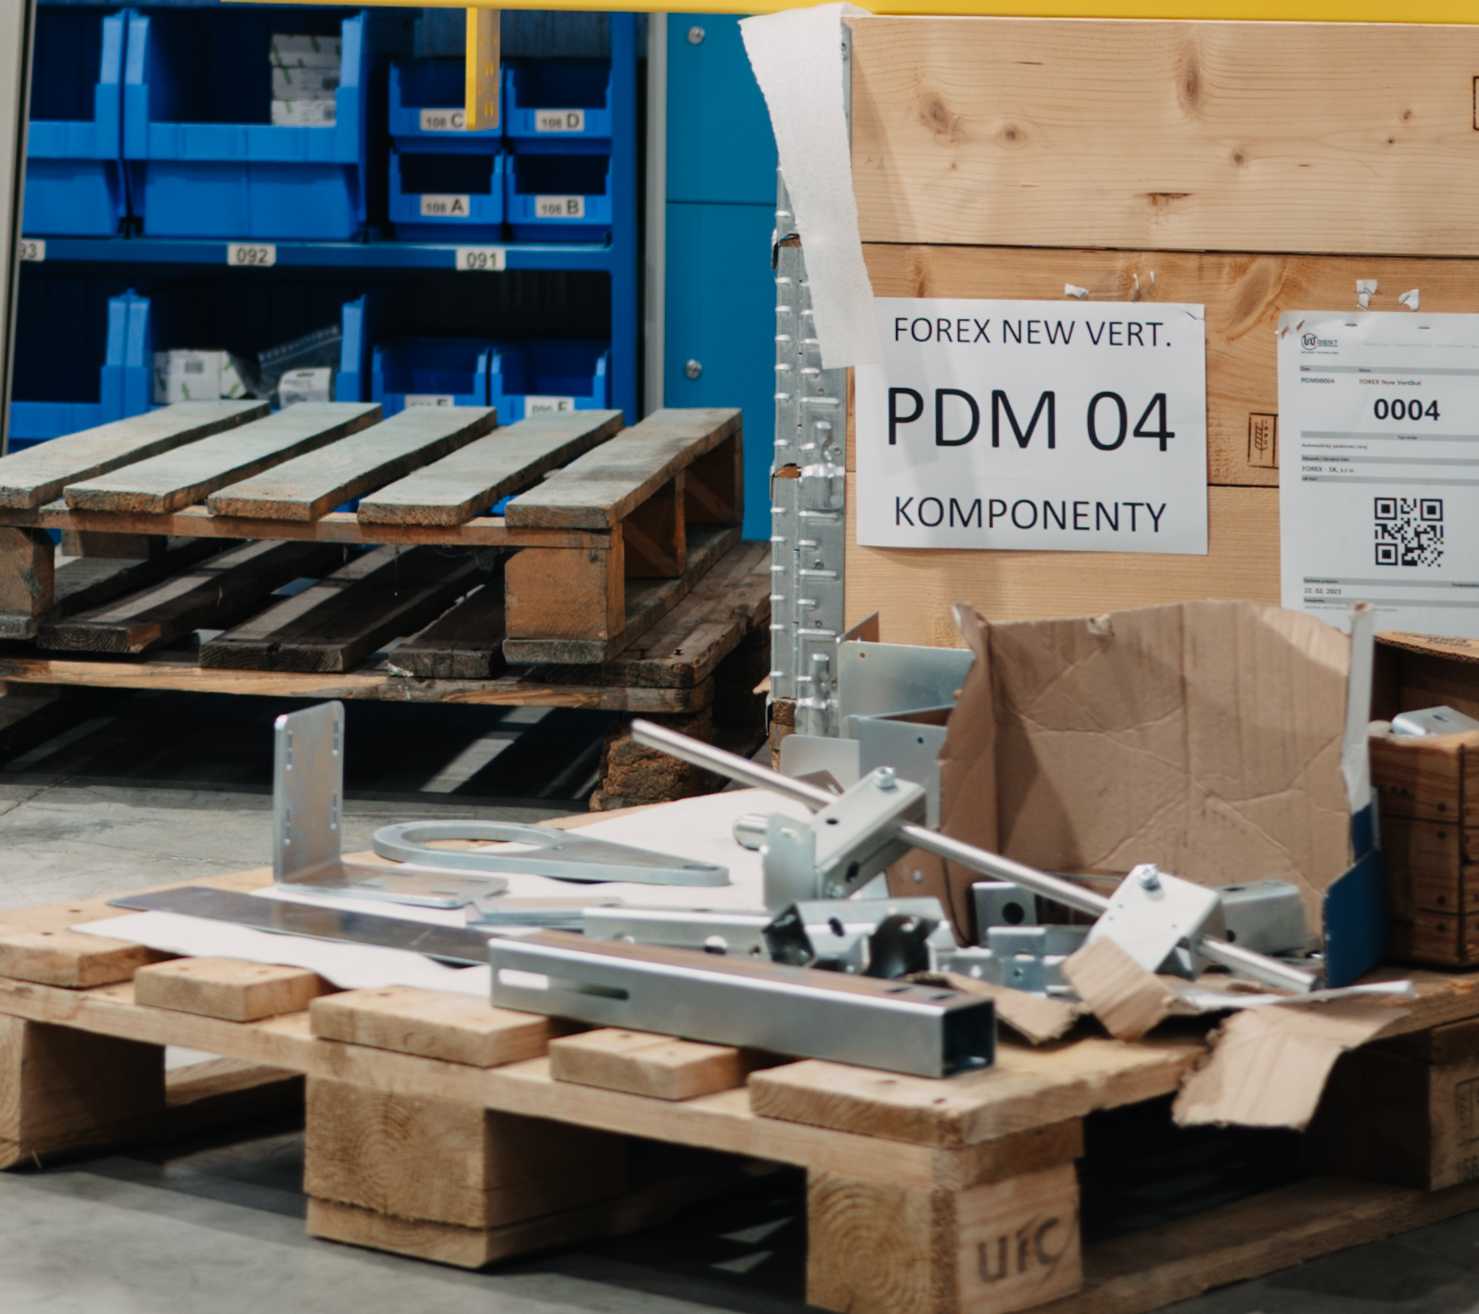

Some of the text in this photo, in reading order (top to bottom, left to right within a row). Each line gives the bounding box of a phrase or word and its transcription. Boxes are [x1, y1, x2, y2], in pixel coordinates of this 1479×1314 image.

[450, 113, 464, 128] C
[567, 113, 580, 129] D
[451, 198, 464, 212] A
[566, 199, 579, 215] B
[20, 243, 38, 260] 93
[236, 248, 268, 264] 092
[467, 252, 497, 267] 091
[894, 317, 1172, 347] FOREX NEW VERT.
[1373, 398, 1441, 421] 0004
[887, 387, 1176, 452] PDM 04
[894, 496, 1168, 533] KOMPONENTY
